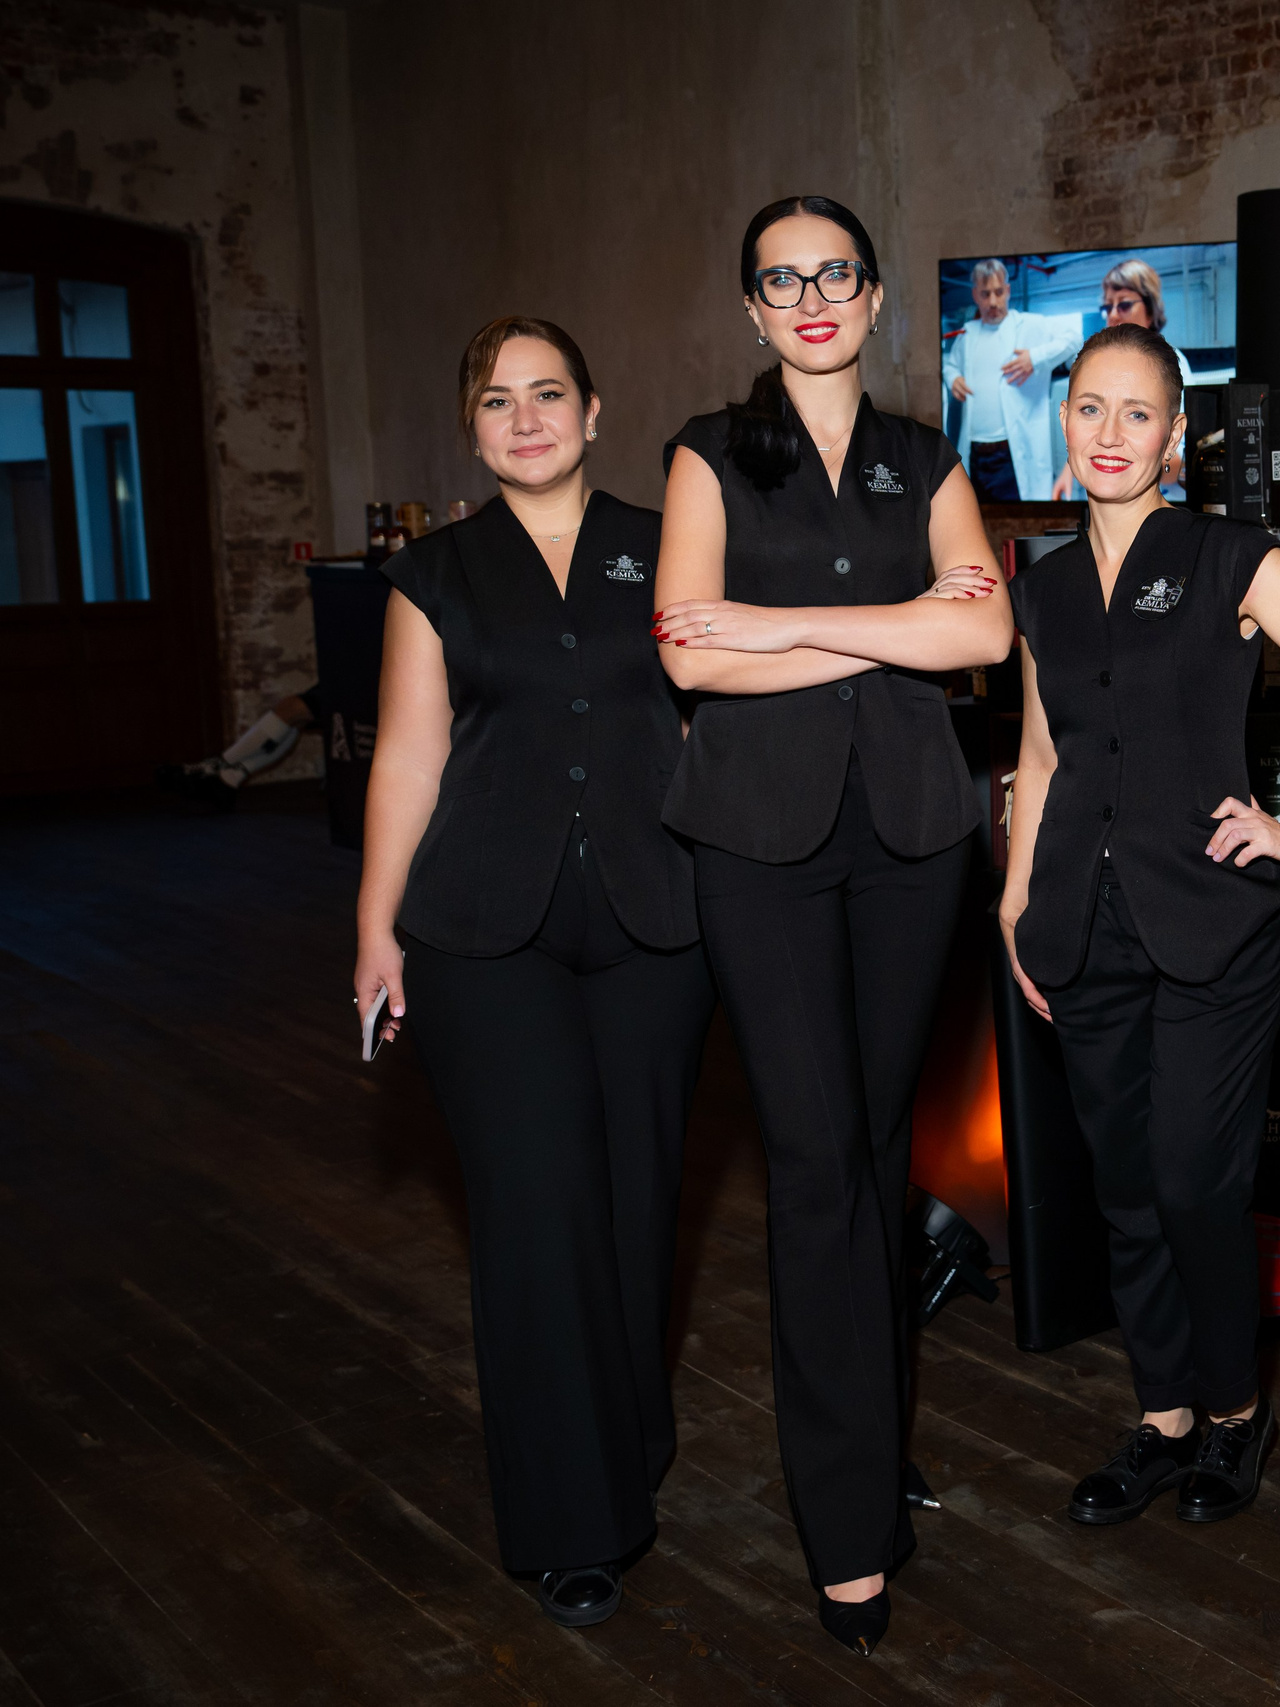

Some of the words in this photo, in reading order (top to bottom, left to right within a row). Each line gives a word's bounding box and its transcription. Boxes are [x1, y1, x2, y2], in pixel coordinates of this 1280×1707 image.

[866, 481, 904, 491] KEMLYA
[606, 570, 645, 579] KEMLYA
[1135, 598, 1169, 609] KEMLYA
